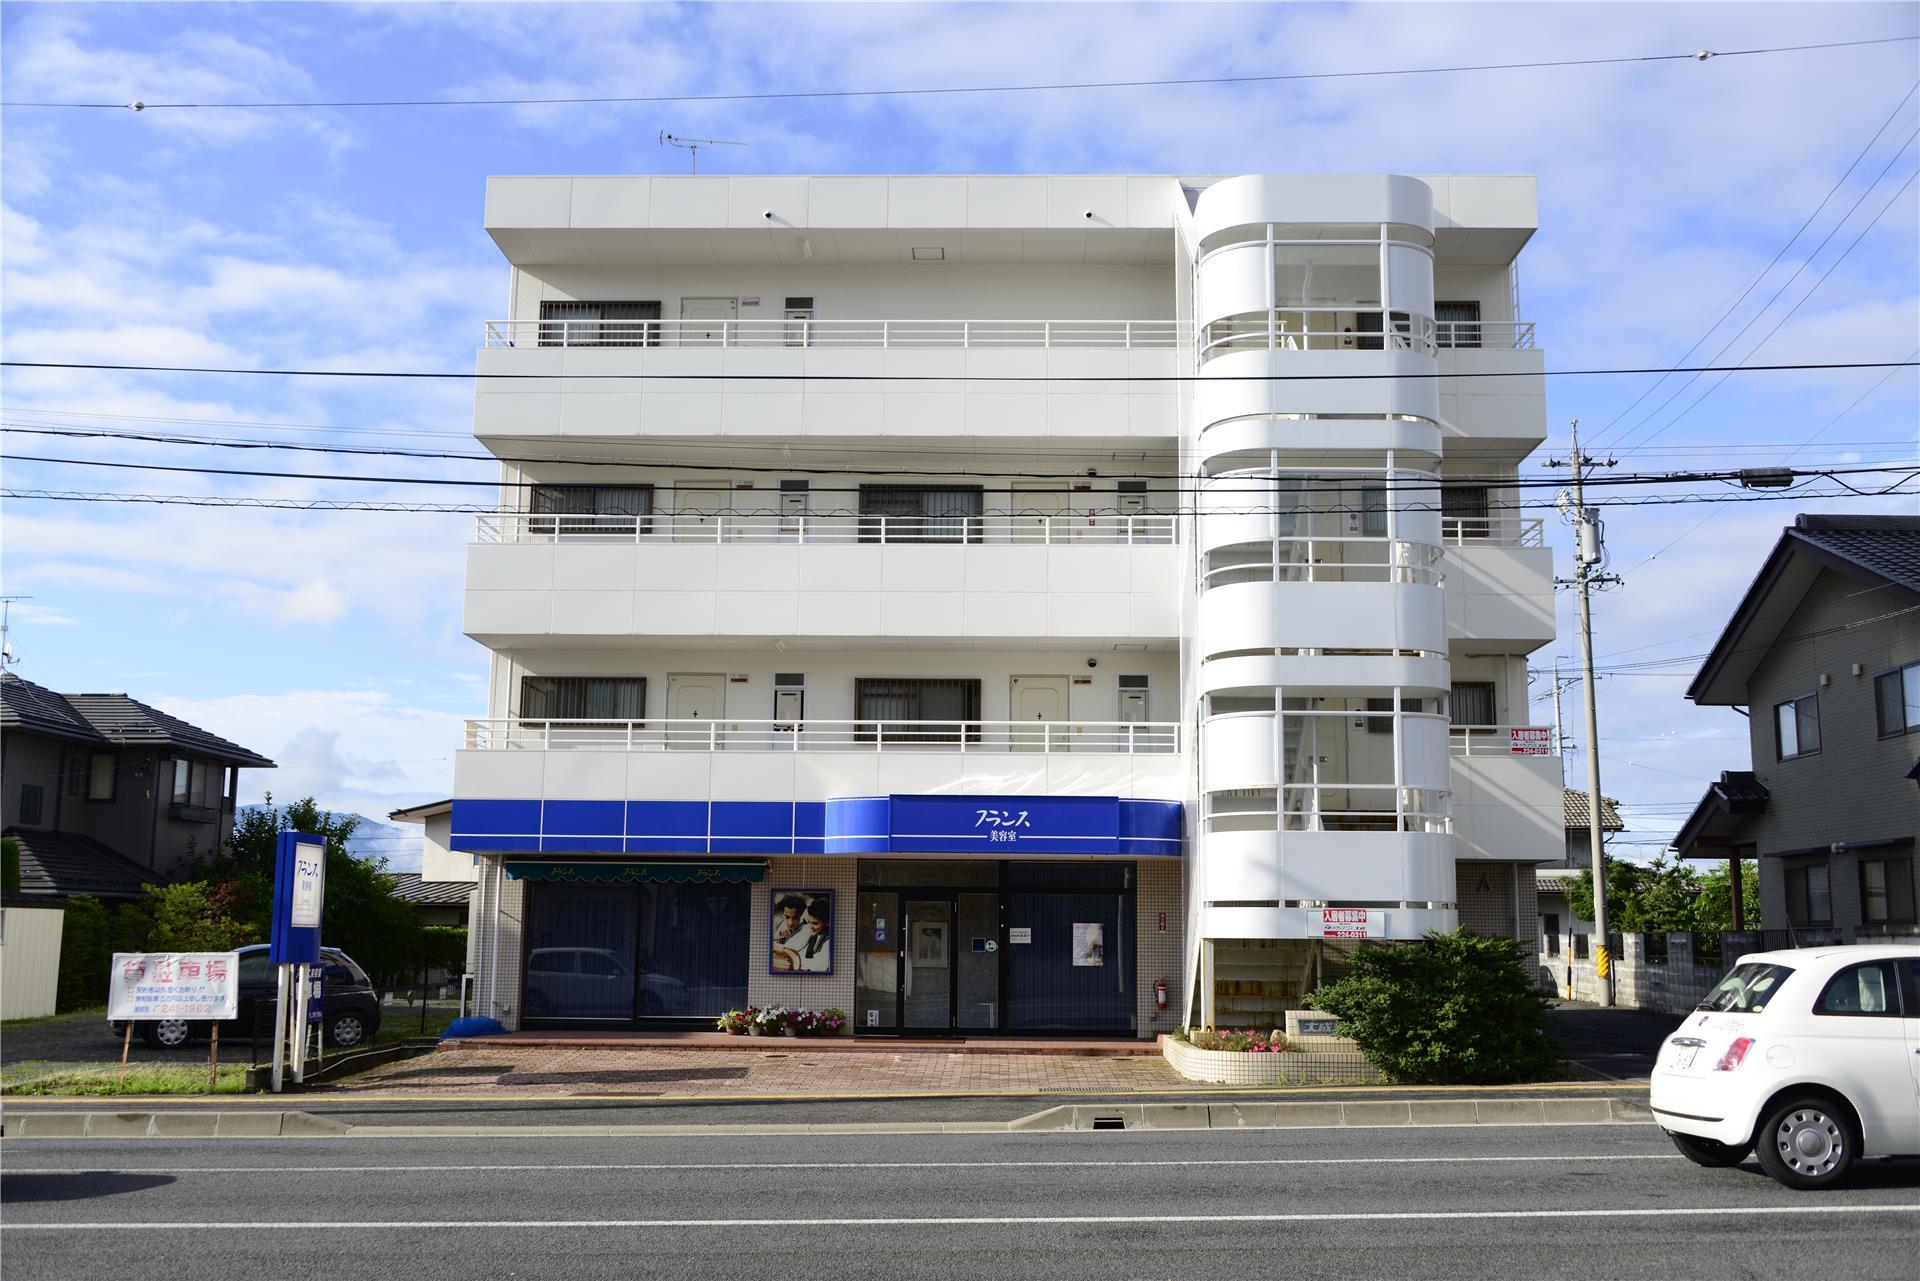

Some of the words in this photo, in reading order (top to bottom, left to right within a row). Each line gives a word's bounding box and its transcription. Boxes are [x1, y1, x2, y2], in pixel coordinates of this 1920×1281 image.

[975, 809, 1030, 827] フランス
[990, 830, 1017, 842] 美容室
